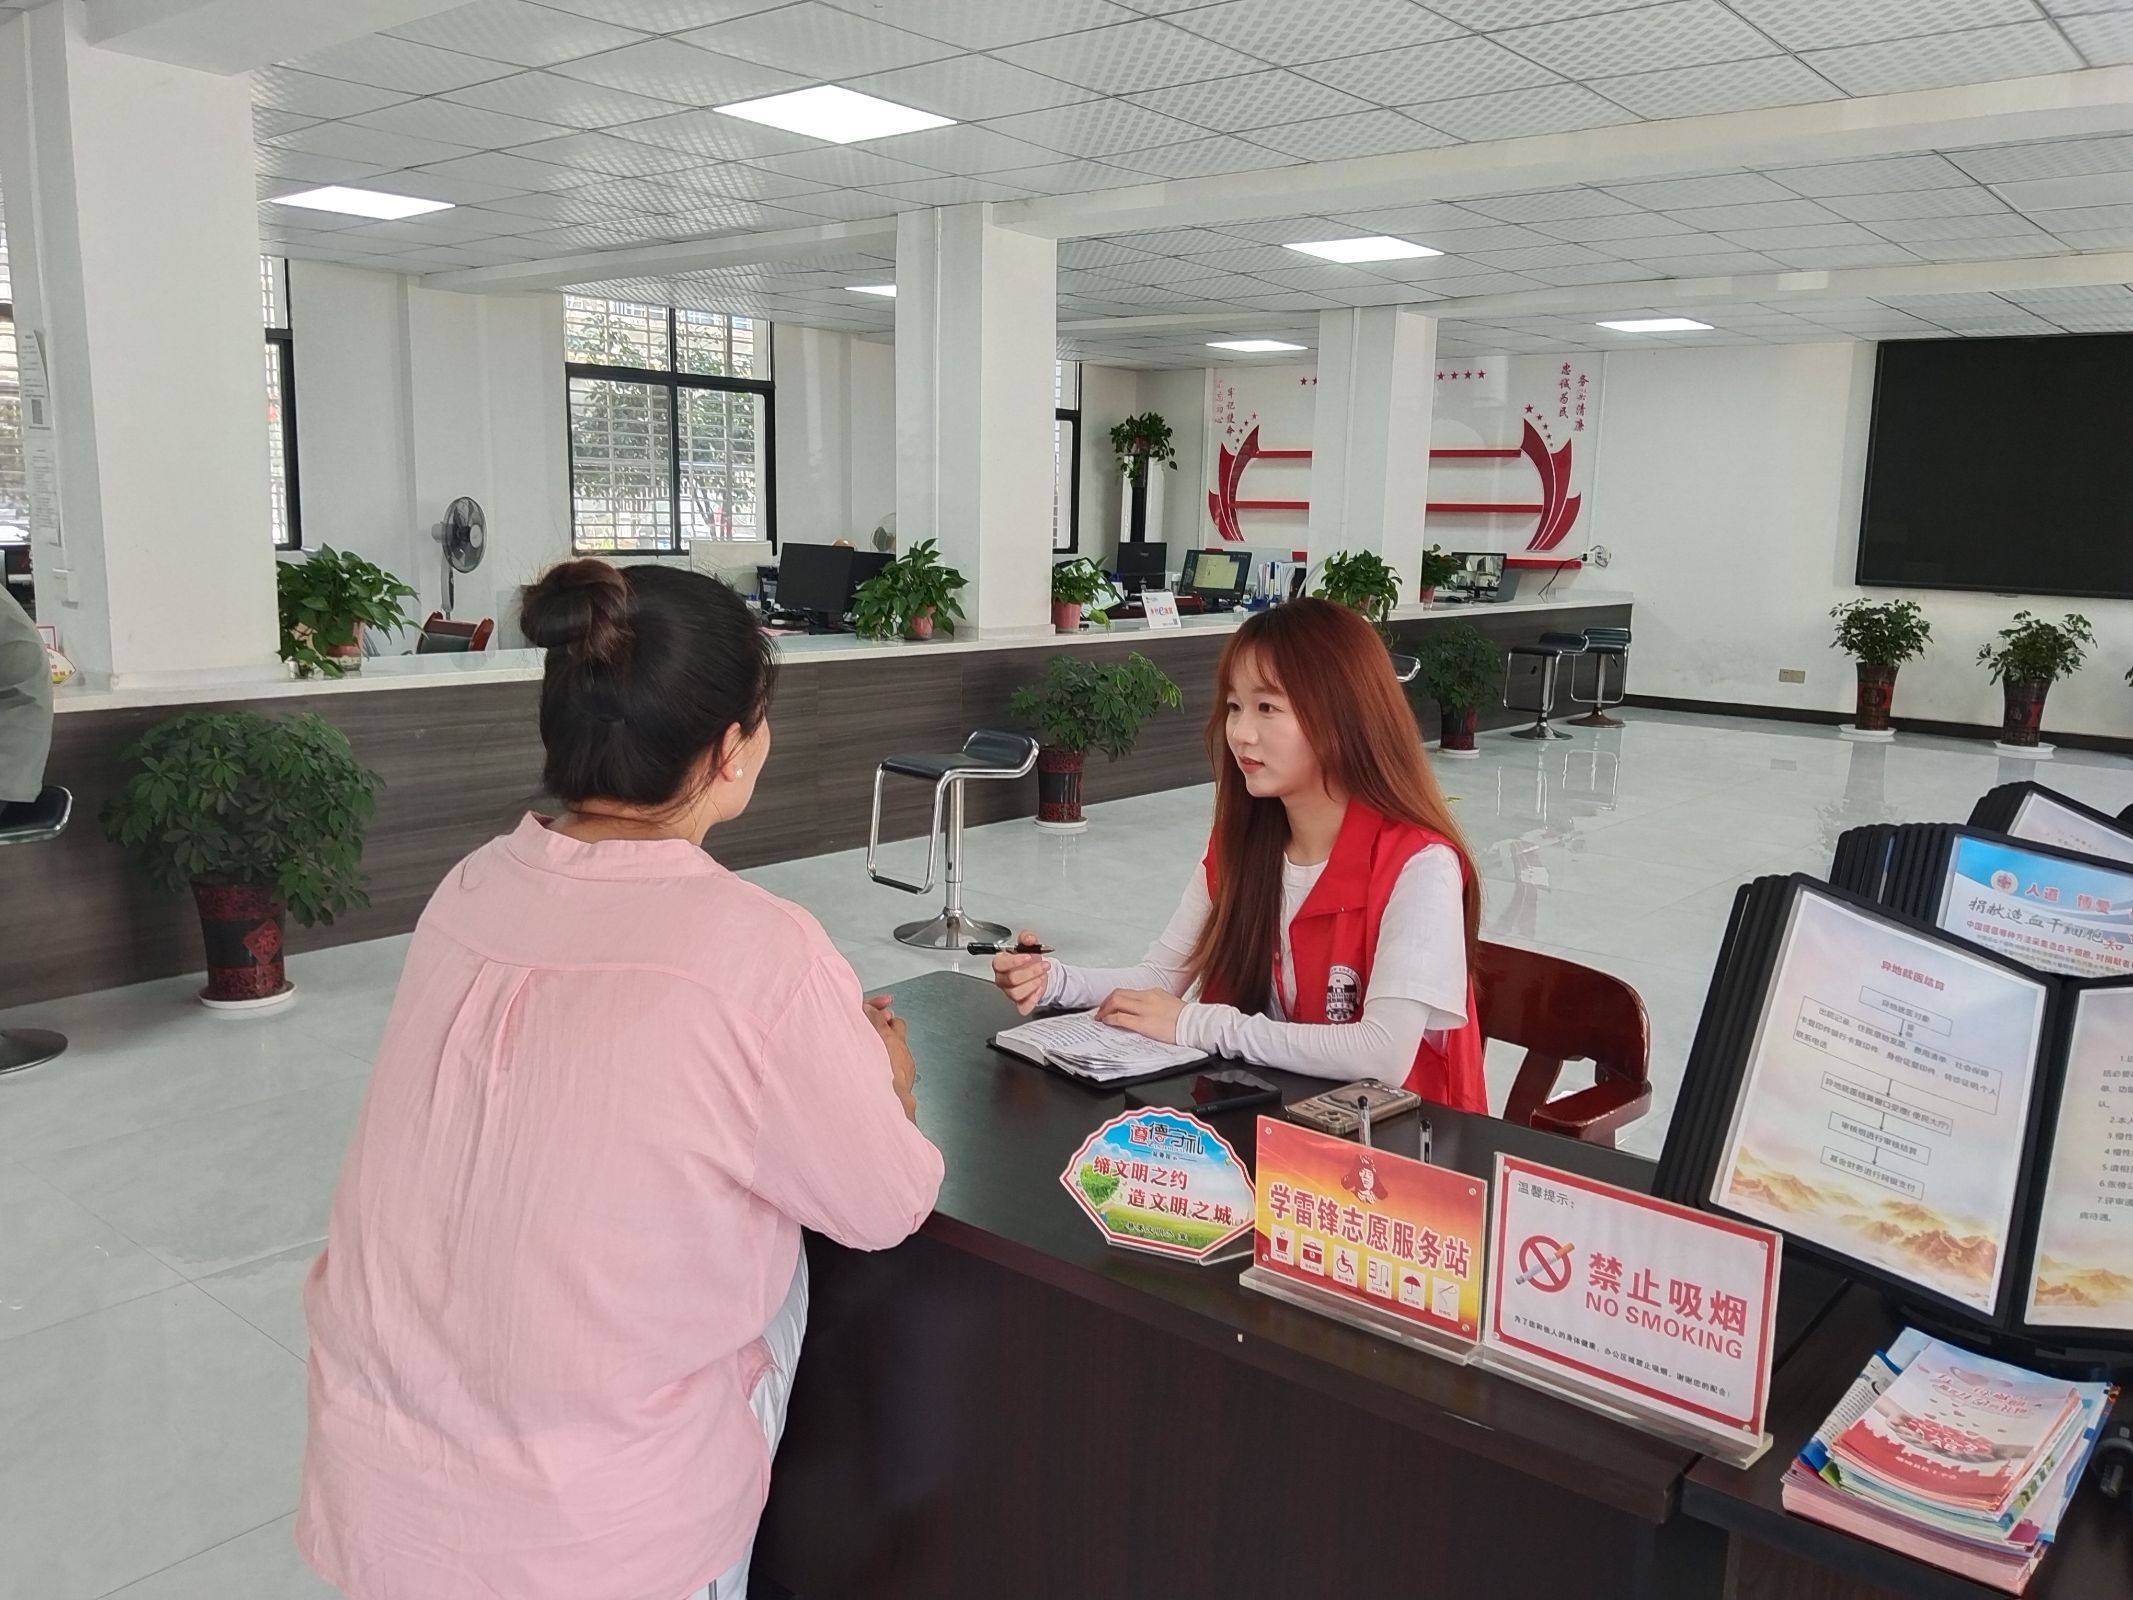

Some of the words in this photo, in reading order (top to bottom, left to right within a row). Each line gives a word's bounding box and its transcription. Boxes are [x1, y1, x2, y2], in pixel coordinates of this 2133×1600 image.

[1093, 1157, 1188, 1191] 缔文明之约
[1127, 1187, 1233, 1226] 造文明之城
[1269, 1183, 1473, 1280] 学雷锋志愿服务站
[1585, 1291, 1620, 1319] NO
[1625, 1305, 1743, 1361] SMOKING
[1587, 1251, 1749, 1338] 禁止吸烟
